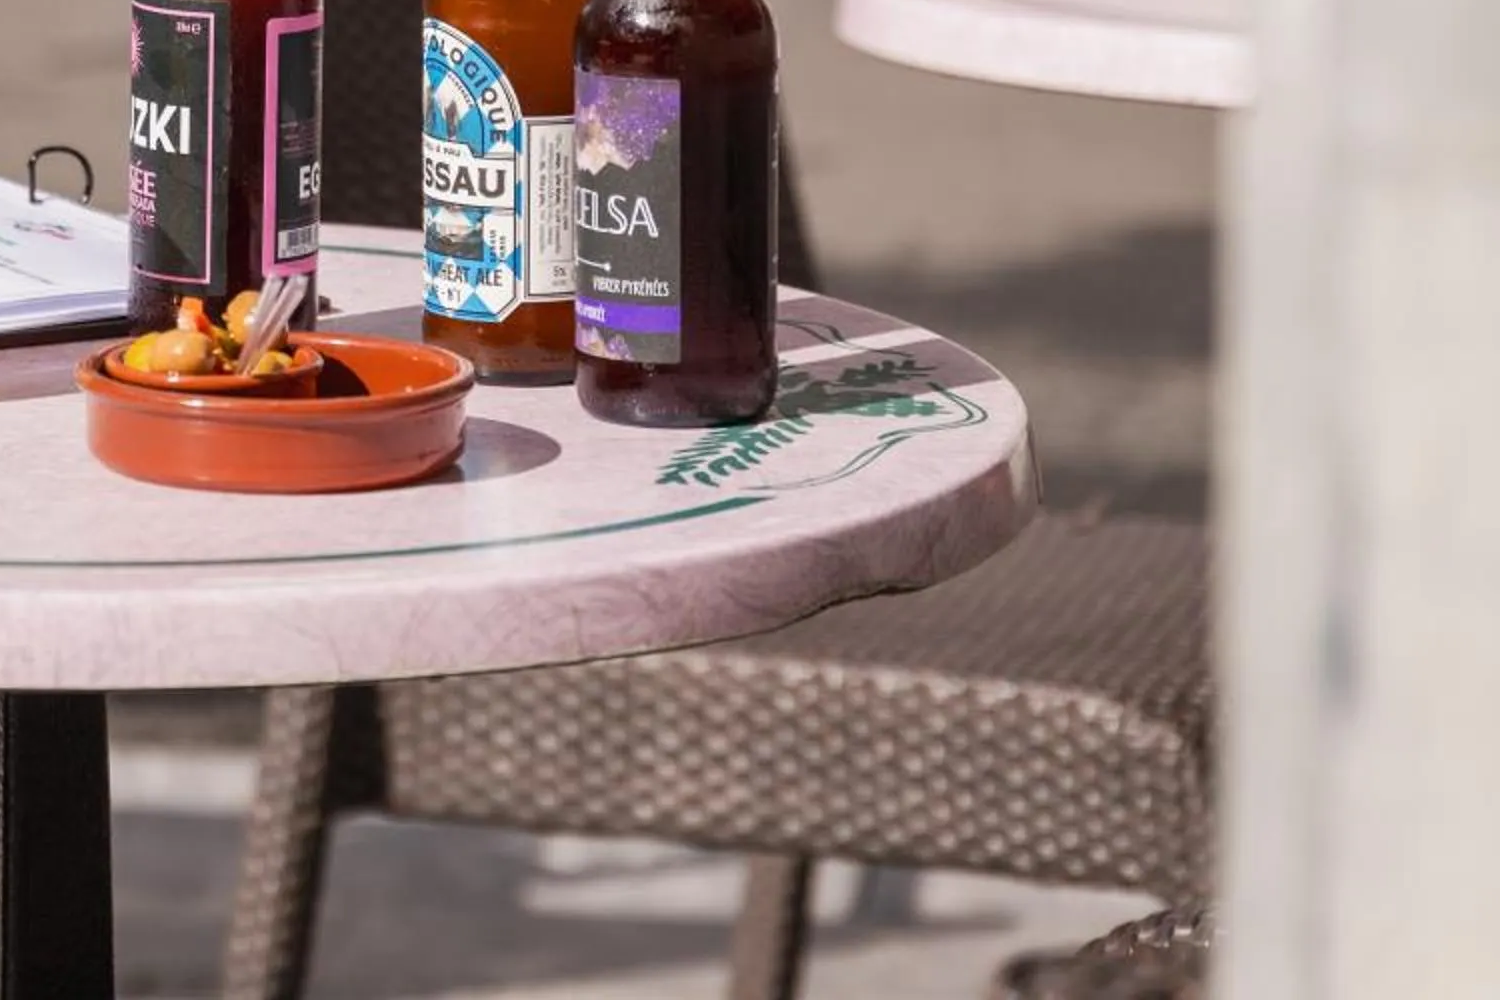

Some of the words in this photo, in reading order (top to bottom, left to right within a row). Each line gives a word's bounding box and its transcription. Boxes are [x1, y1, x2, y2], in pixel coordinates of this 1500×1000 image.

[130, 95, 191, 155] ZKI
[424, 156, 507, 199] SSAU
[475, 266, 504, 287] ALE
